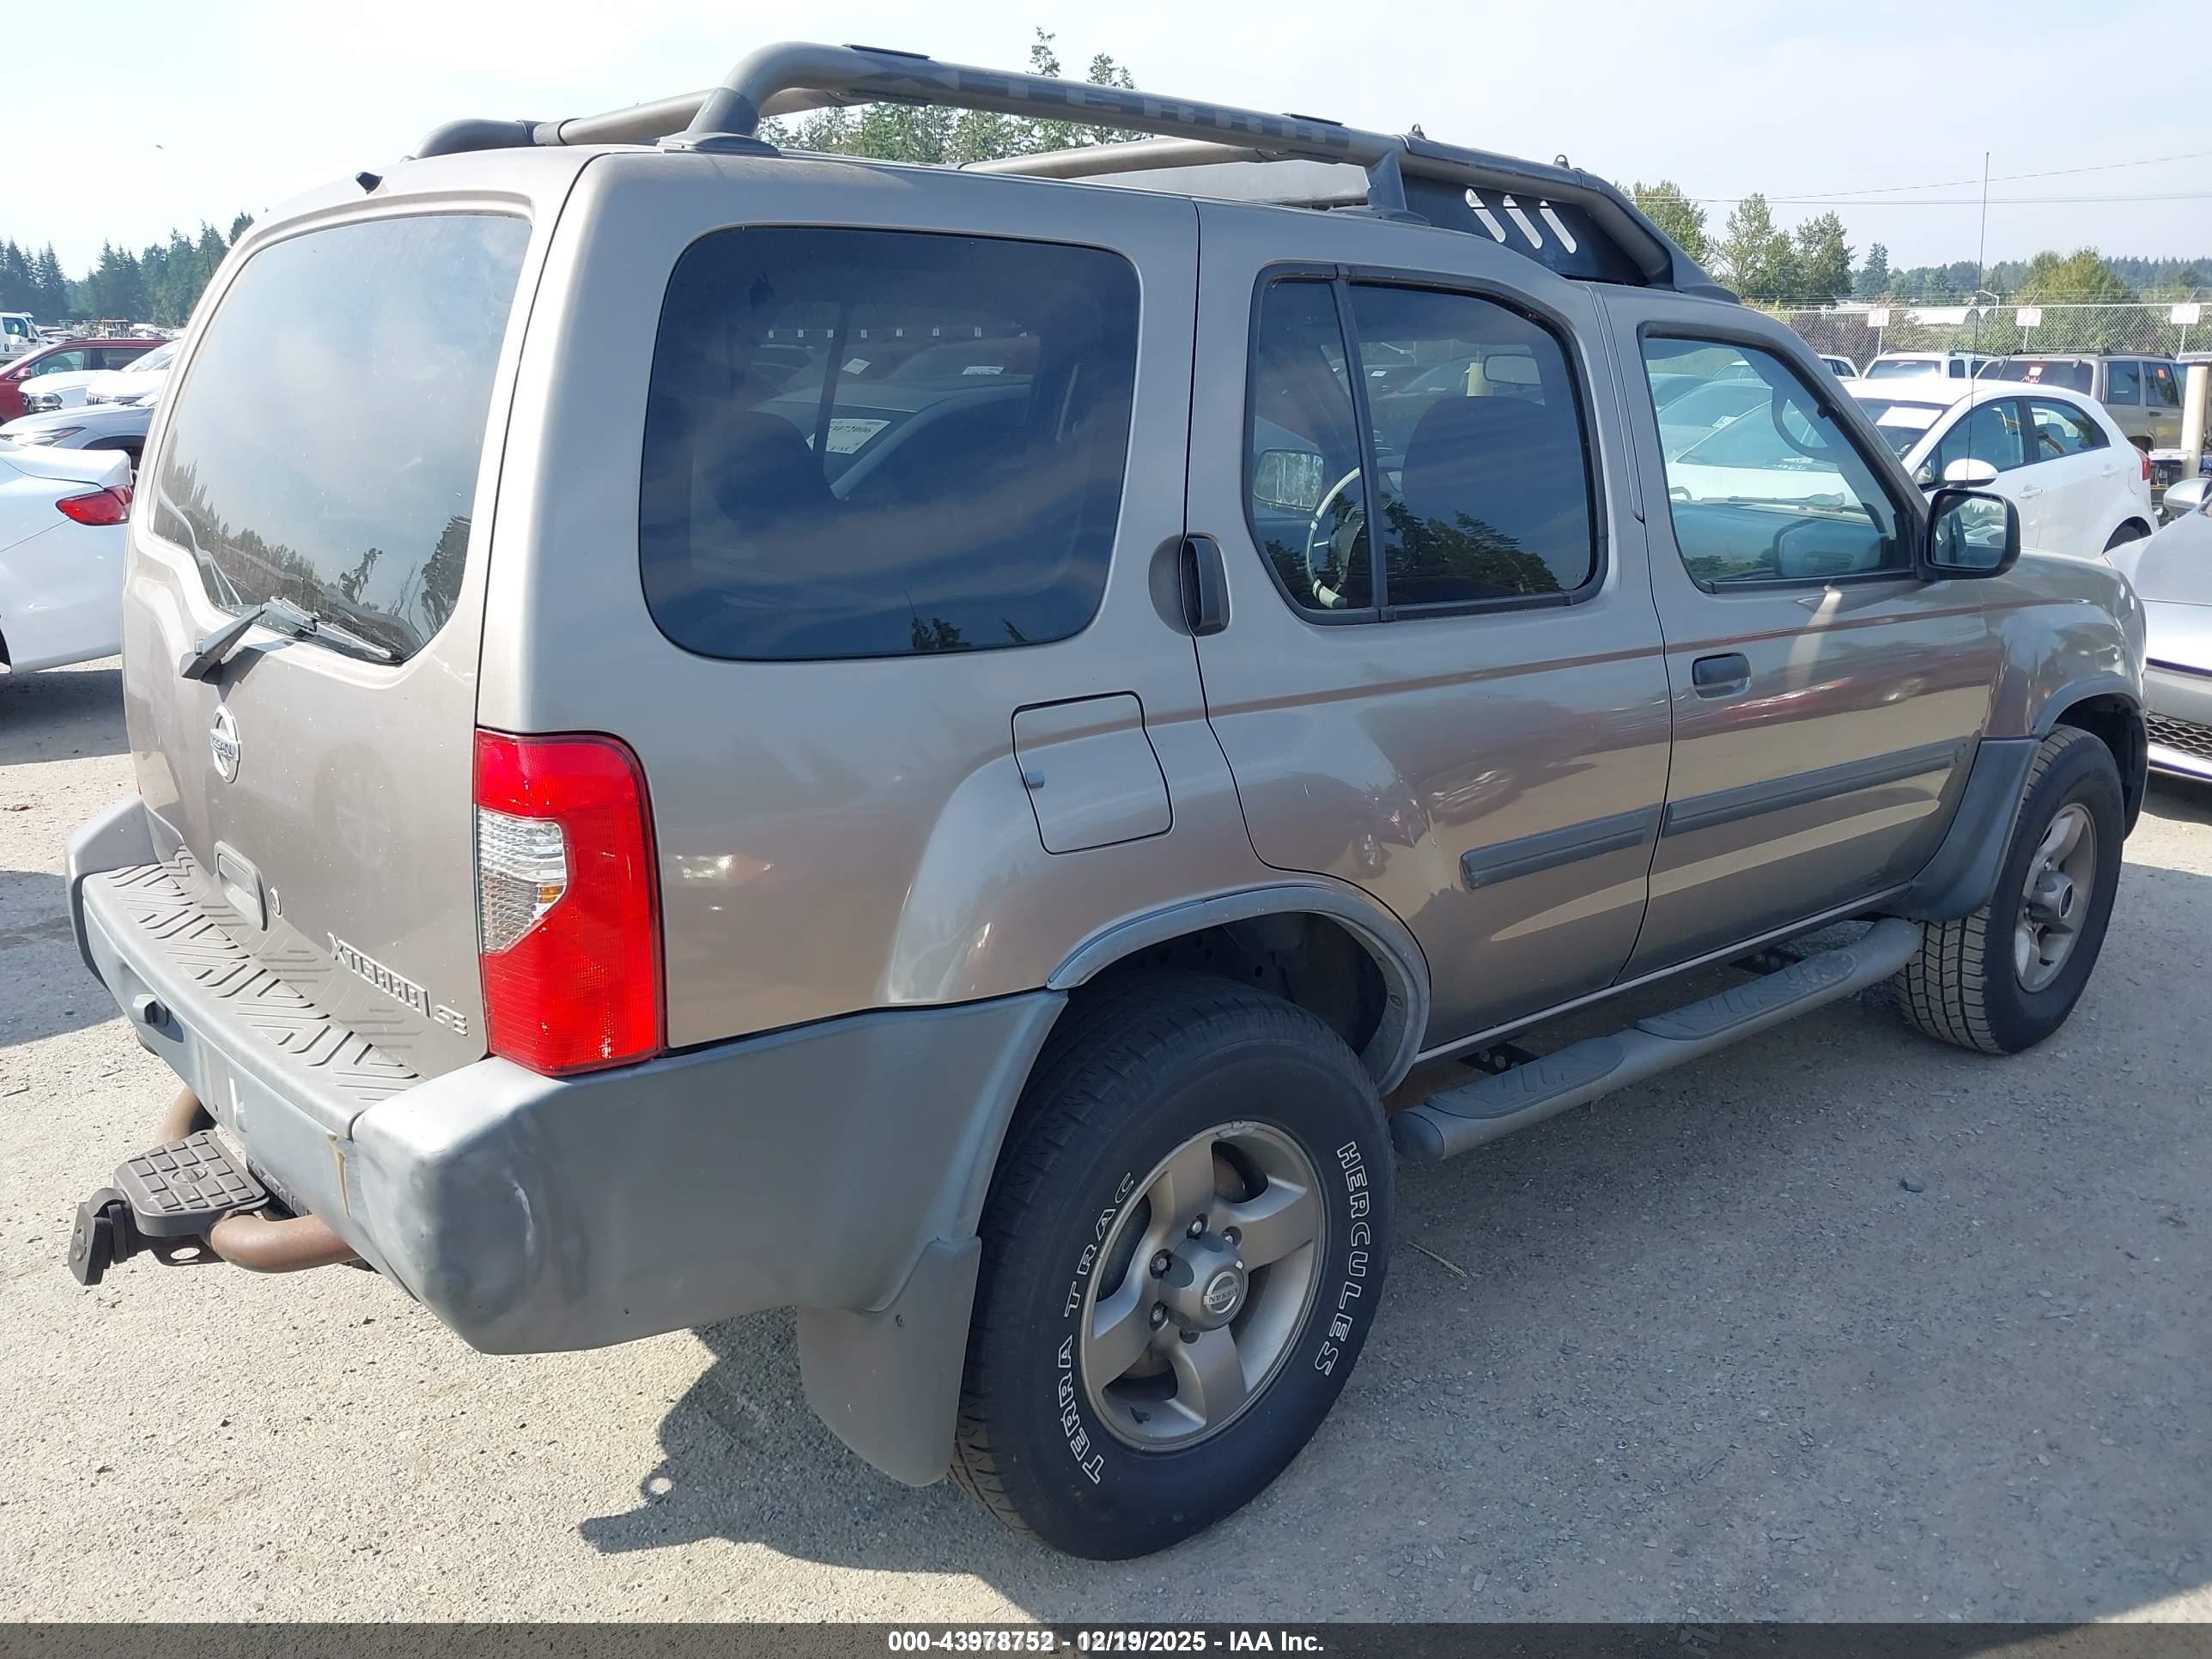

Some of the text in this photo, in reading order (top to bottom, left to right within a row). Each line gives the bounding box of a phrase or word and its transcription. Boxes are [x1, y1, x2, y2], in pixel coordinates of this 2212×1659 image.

[852, 57, 1350, 150] XTERRA
[2020, 309, 2039, 325] 22
[326, 930, 470, 1036] XTERRA SE
[1315, 1140, 1371, 1376] HERCULES
[1057, 1171, 1134, 1485] TERRA TRAC
